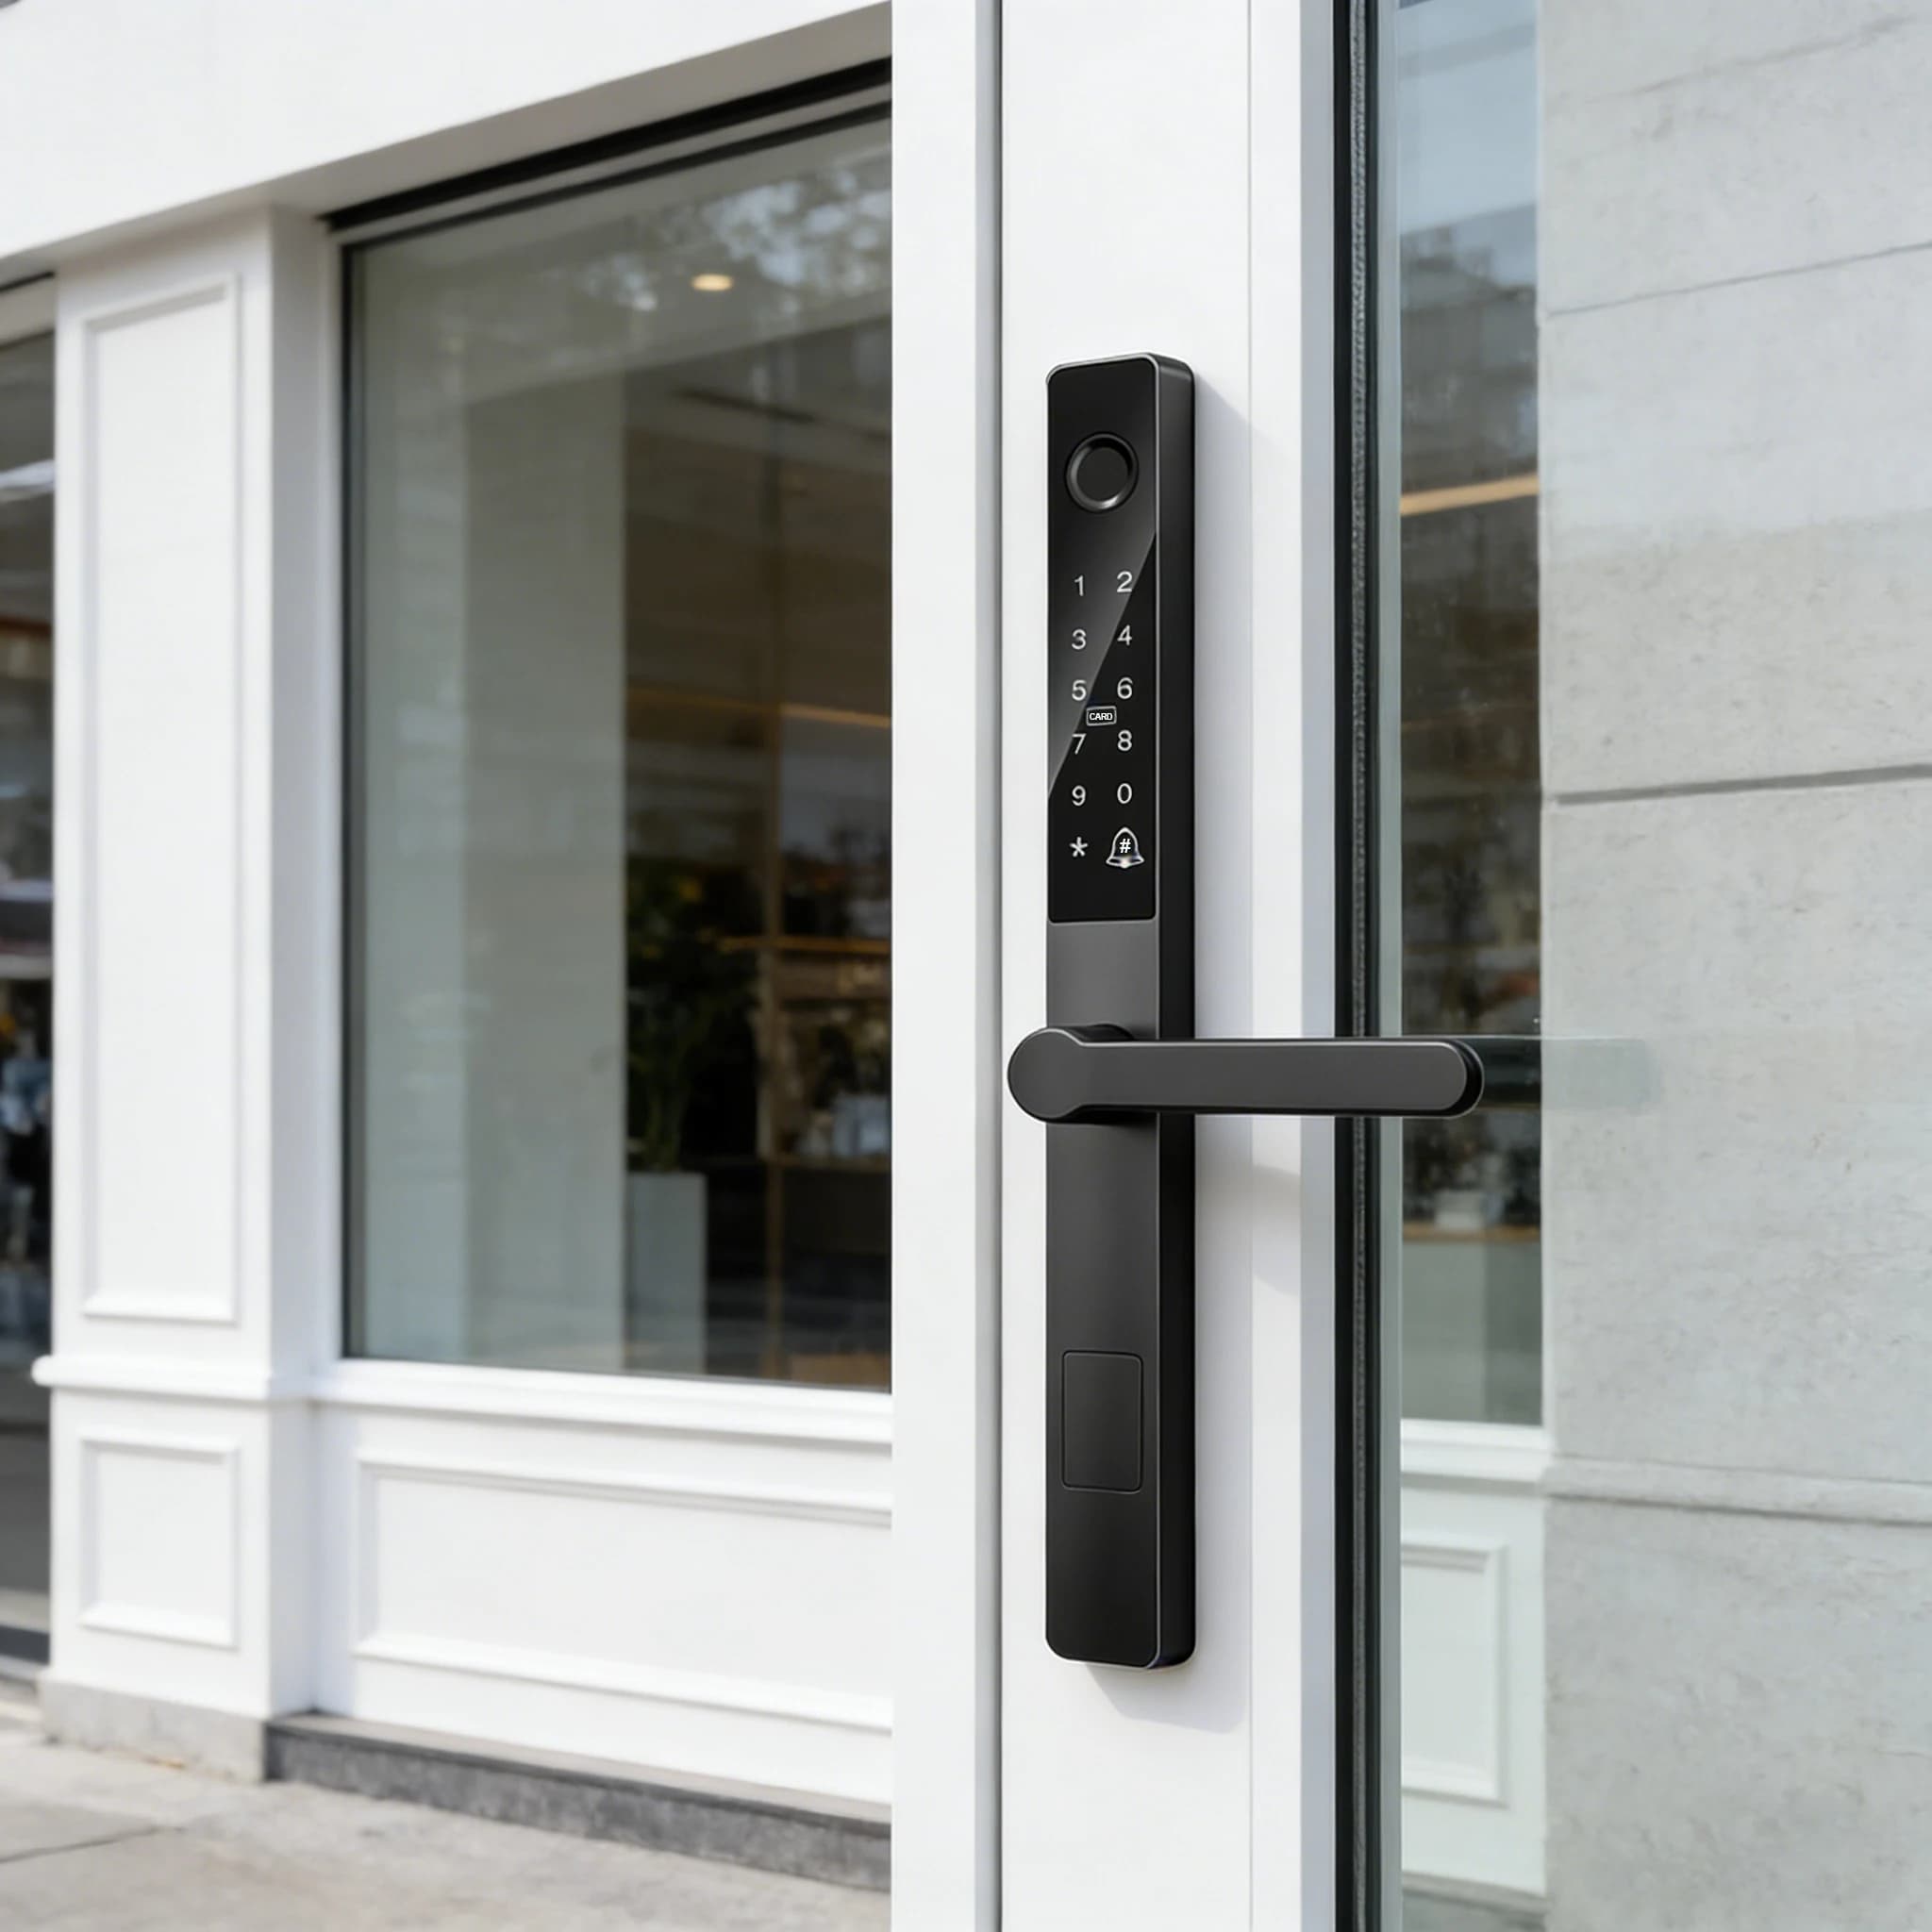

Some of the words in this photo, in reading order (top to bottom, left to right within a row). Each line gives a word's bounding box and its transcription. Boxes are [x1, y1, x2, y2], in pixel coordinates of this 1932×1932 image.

[1074, 575, 1084, 596] 1
[1116, 571, 1133, 593] 2
[1071, 628, 1087, 650] 3
[1117, 625, 1133, 645] 4
[1071, 679, 1087, 702] 5
[1117, 676, 1133, 700] 6
[1089, 712, 1113, 721] CARD
[1071, 733, 1087, 755] 7
[1117, 729, 1133, 752] 8
[1072, 785, 1086, 807] 9
[1117, 783, 1133, 805] 0
[1119, 838, 1131, 854] #
